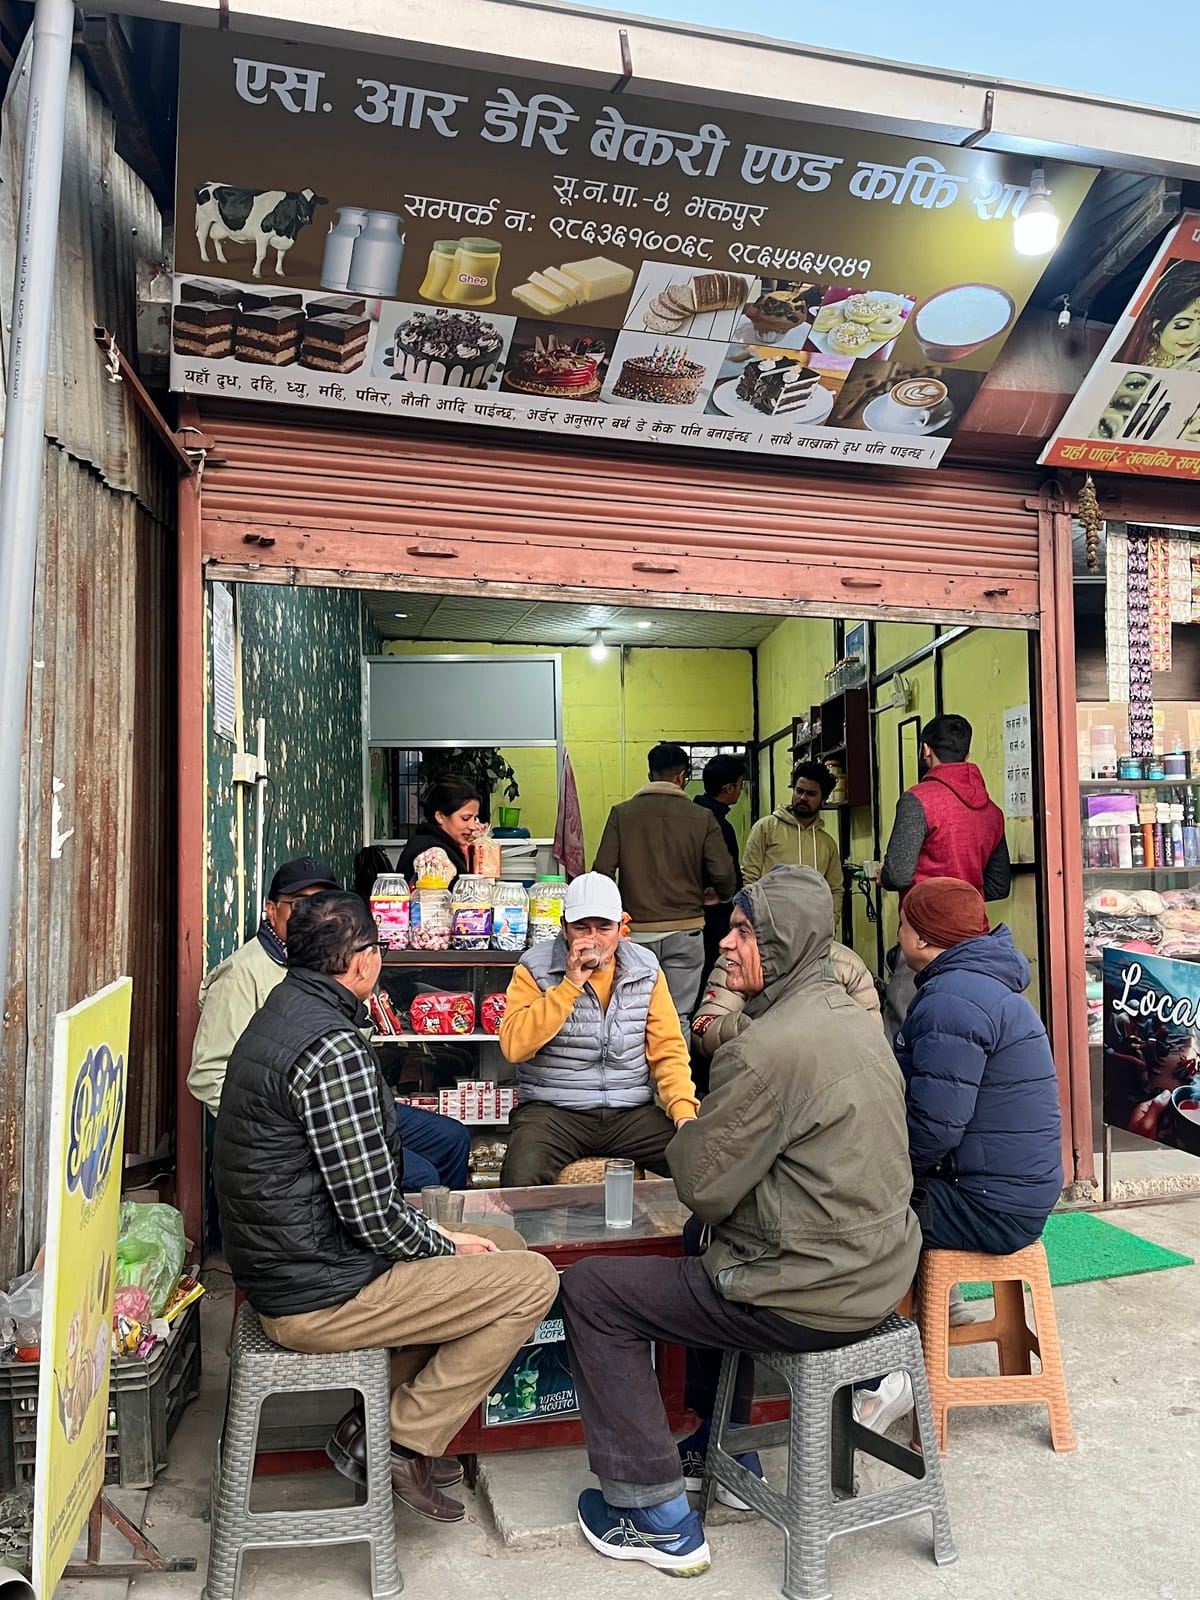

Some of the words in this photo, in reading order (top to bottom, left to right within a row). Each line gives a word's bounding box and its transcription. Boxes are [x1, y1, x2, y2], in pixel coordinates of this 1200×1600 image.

[233, 57, 332, 113] एस.
[354, 78, 469, 138] आर
[480, 87, 581, 156] डेरि
[590, 106, 731, 177] बेकरी
[740, 142, 844, 194] एण्ड
[849, 155, 969, 209] कफि
[684, 195, 769, 231] भक्तपुर
[404, 193, 500, 228] सम्पर्क
[728, 242, 872, 279] ९८६५४६५९४१
[459, 273, 488, 287] Ghee
[184, 367, 211, 386] यहाँ
[216, 374, 242, 390] दुध,
[251, 375, 277, 394] दहि,
[319, 383, 347, 402] महि,
[401, 391, 431, 408] नौनी
[436, 397, 468, 413] आदि
[527, 408, 559, 424] अर्डर
[563, 413, 608, 430] अनुसार
[612, 416, 631, 429] बर्थ
[635, 418, 647, 432] डे
[651, 420, 676, 434] केक
[681, 422, 703, 437] पनि
[770, 431, 794, 446] साथै
[843, 441, 862, 455] दुध
[866, 441, 887, 454] पनि
[539, 1389, 573, 1404] VIRGIN
[540, 1399, 574, 1412] MOJITO
